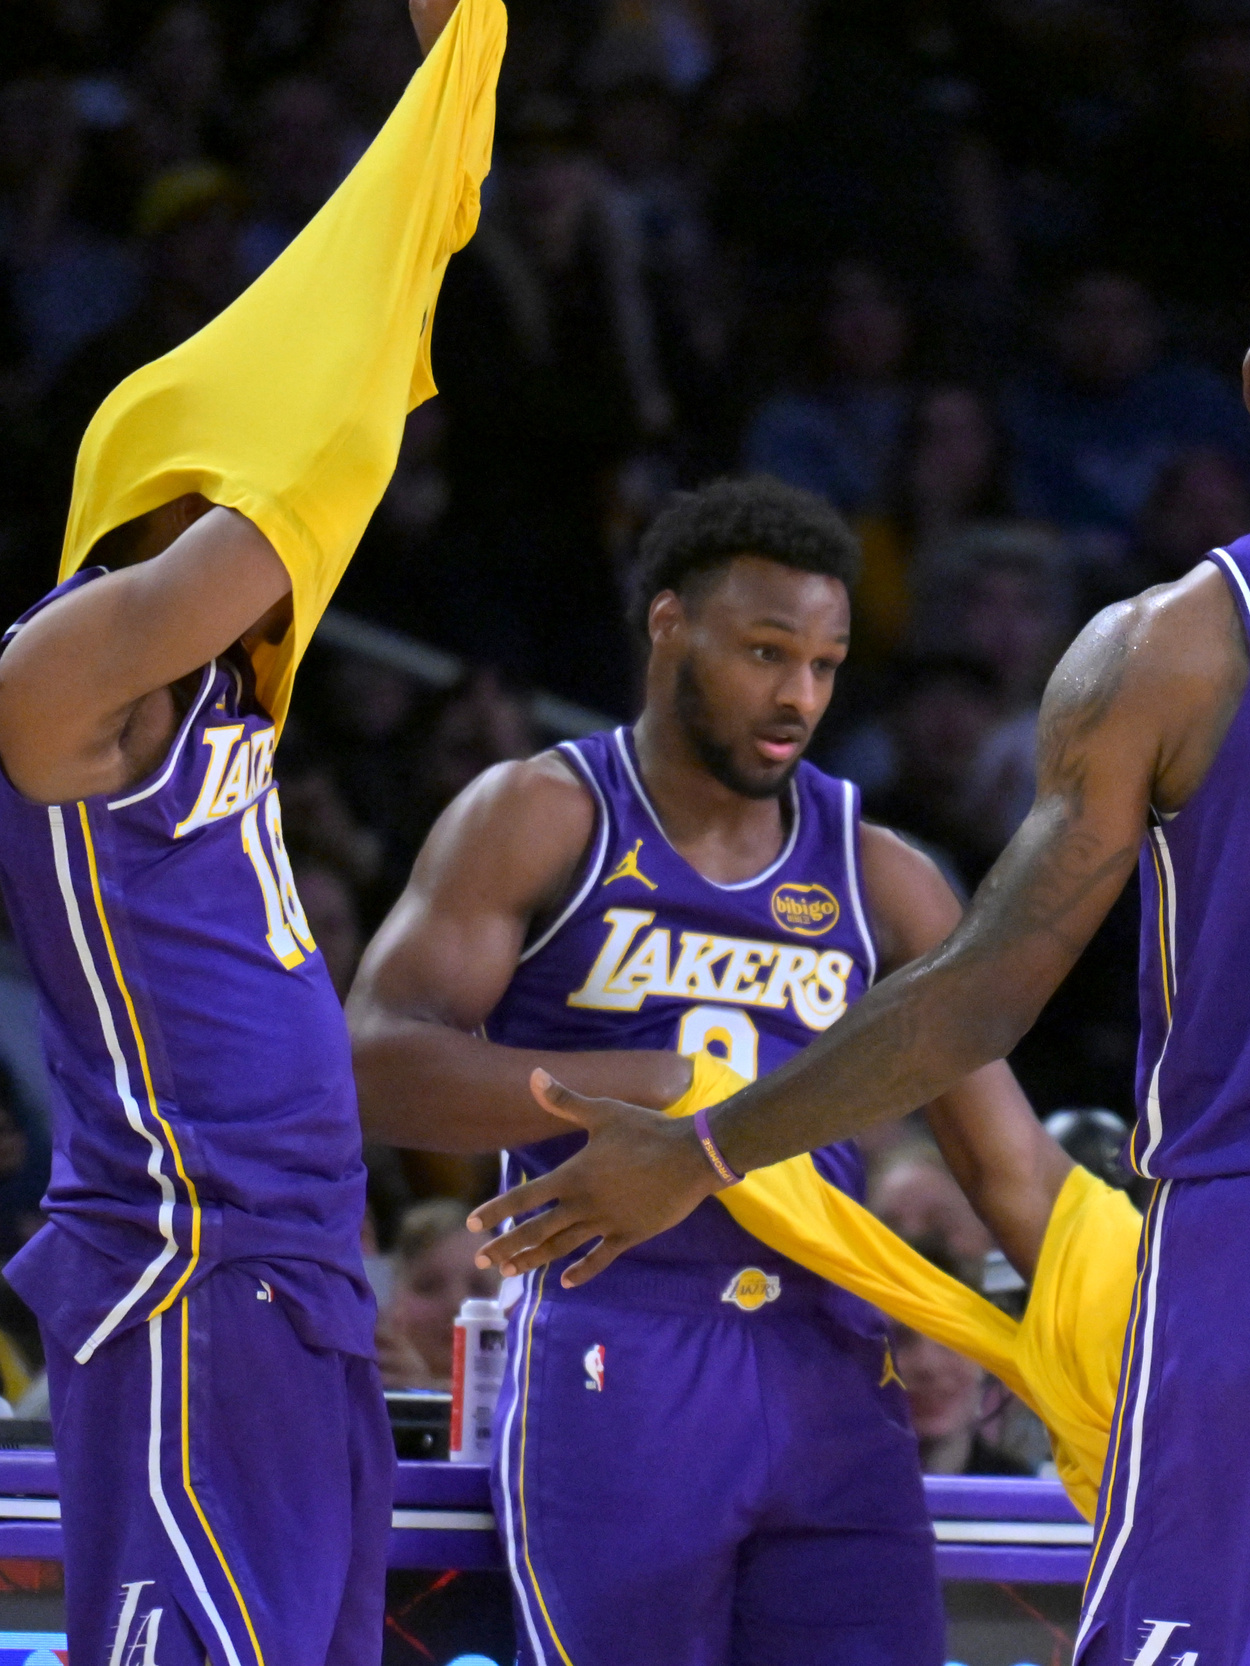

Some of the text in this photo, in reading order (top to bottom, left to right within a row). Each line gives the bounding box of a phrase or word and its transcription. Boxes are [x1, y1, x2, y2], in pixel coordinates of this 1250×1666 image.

[173, 723, 276, 840] LAKE
[775, 895, 835, 922] bibigo
[567, 908, 853, 1031] LAKERS
[701, 1137, 731, 1180] PROMISE
